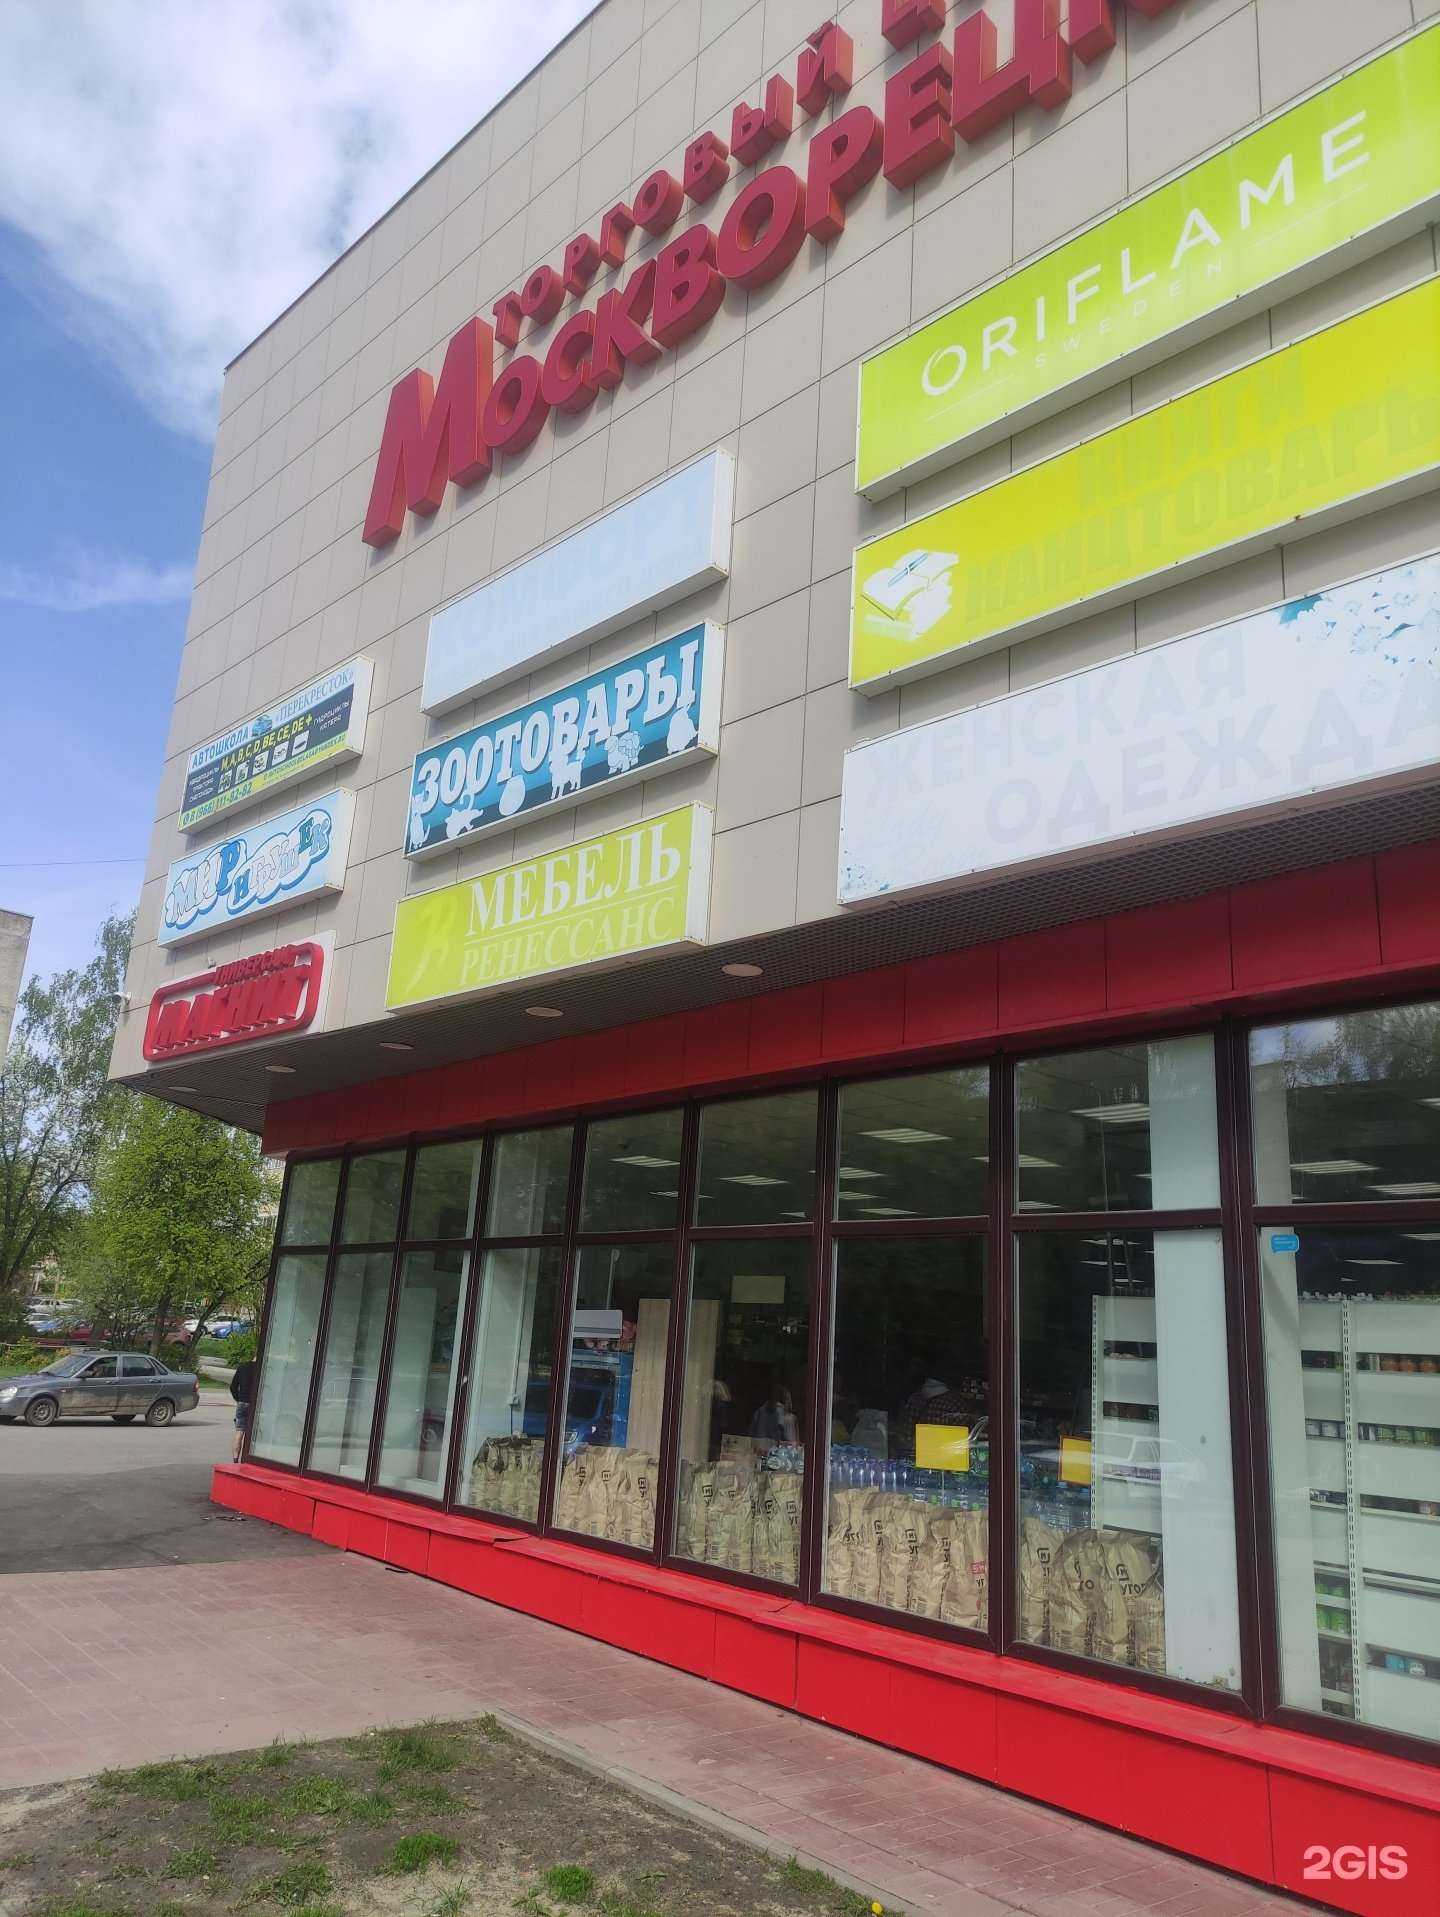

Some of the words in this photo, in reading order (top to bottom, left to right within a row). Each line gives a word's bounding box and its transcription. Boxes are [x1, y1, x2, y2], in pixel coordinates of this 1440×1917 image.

[492, 20, 853, 348] ТОРГОВЫЙ
[921, 110, 1370, 396] ORIFLAME
[1033, 259, 1224, 369] SWEDEN
[191, 726, 249, 768] АВТОШКОЛА
[417, 639, 699, 814] ЗООТОВАРЫ
[864, 630, 1247, 809] ЖЕНСКАЯ
[460, 897, 675, 987] РЕНЕССАНС
[467, 821, 682, 938] МЕБЕЛЬ
